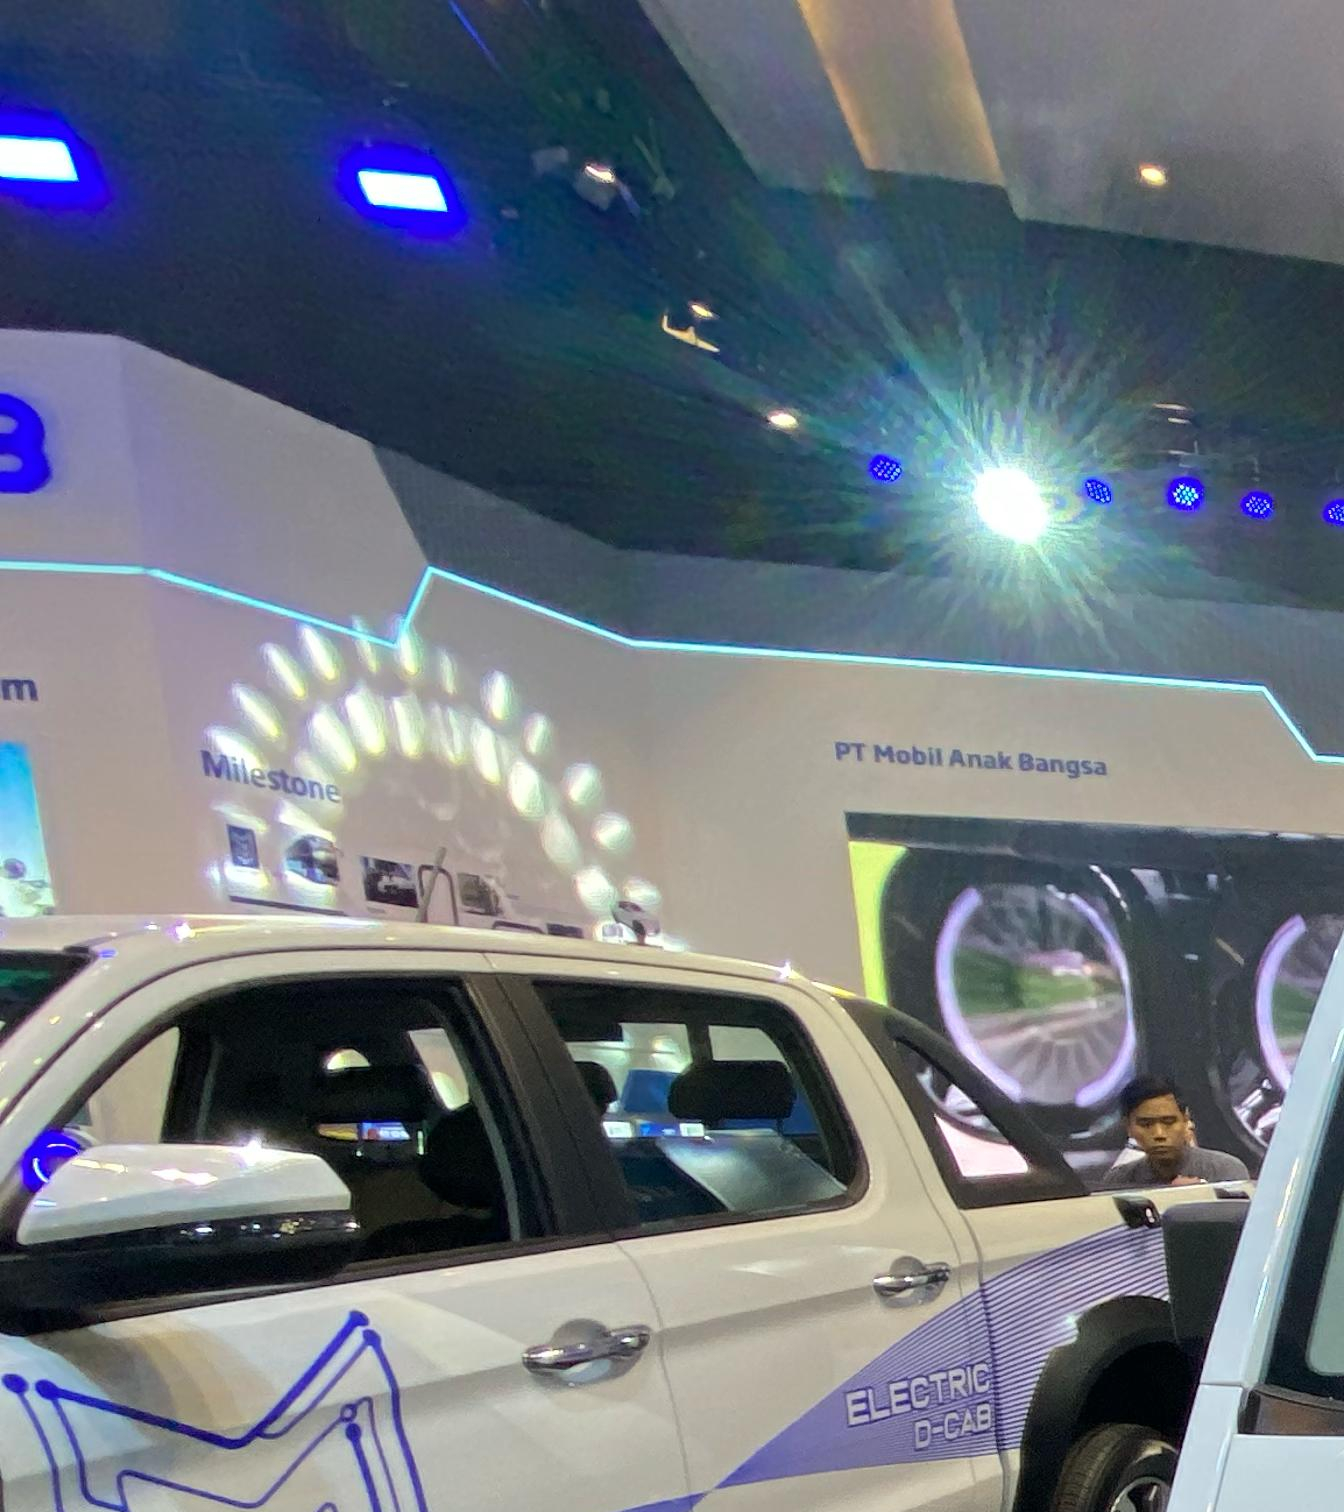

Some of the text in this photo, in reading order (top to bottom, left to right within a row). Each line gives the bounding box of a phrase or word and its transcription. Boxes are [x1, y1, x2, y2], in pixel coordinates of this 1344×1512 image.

[201, 749, 342, 803] Milestone
[835, 741, 1109, 780] PT Mobil Anak Bangsa
[845, 1361, 992, 1427] ELECTRIC
[914, 1402, 992, 1450] D-CAB
